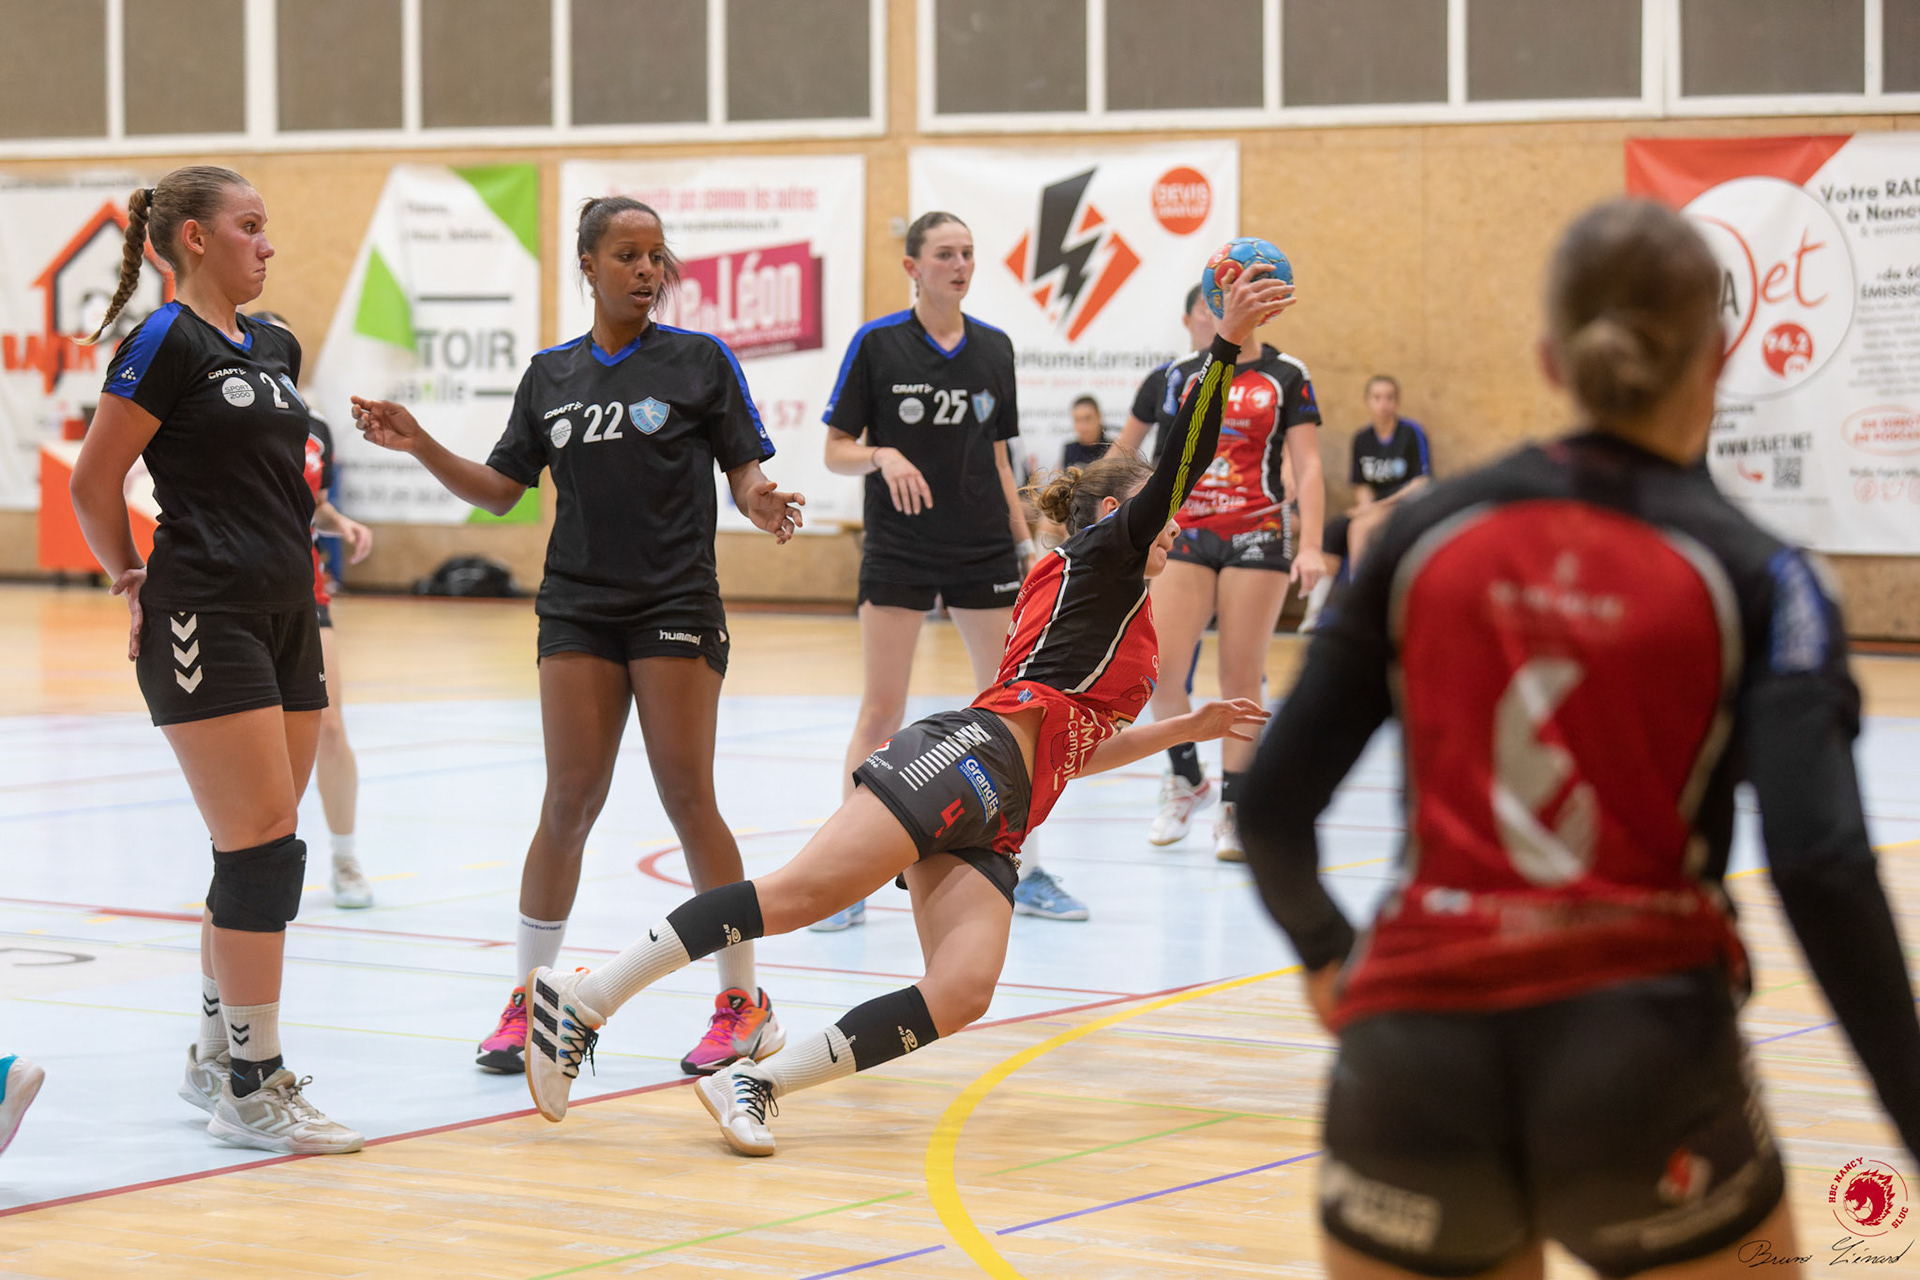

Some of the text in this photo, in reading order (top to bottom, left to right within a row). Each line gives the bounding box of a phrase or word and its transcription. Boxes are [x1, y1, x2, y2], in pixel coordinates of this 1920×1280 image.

[1820, 183, 1878, 203] Votre
[414, 329, 517, 370] TOIR
[207, 368, 239, 380] CRAFT
[224, 384, 249, 393] SPORT
[230, 391, 251, 400] 2000
[891, 384, 925, 395] CRAFT
[543, 402, 576, 420] CRAFT
[933, 389, 968, 425] 25
[583, 401, 625, 443] 22
[659, 630, 701, 646] hummel
[1493, 657, 1598, 886] 6
[934, 798, 965, 838] 4
